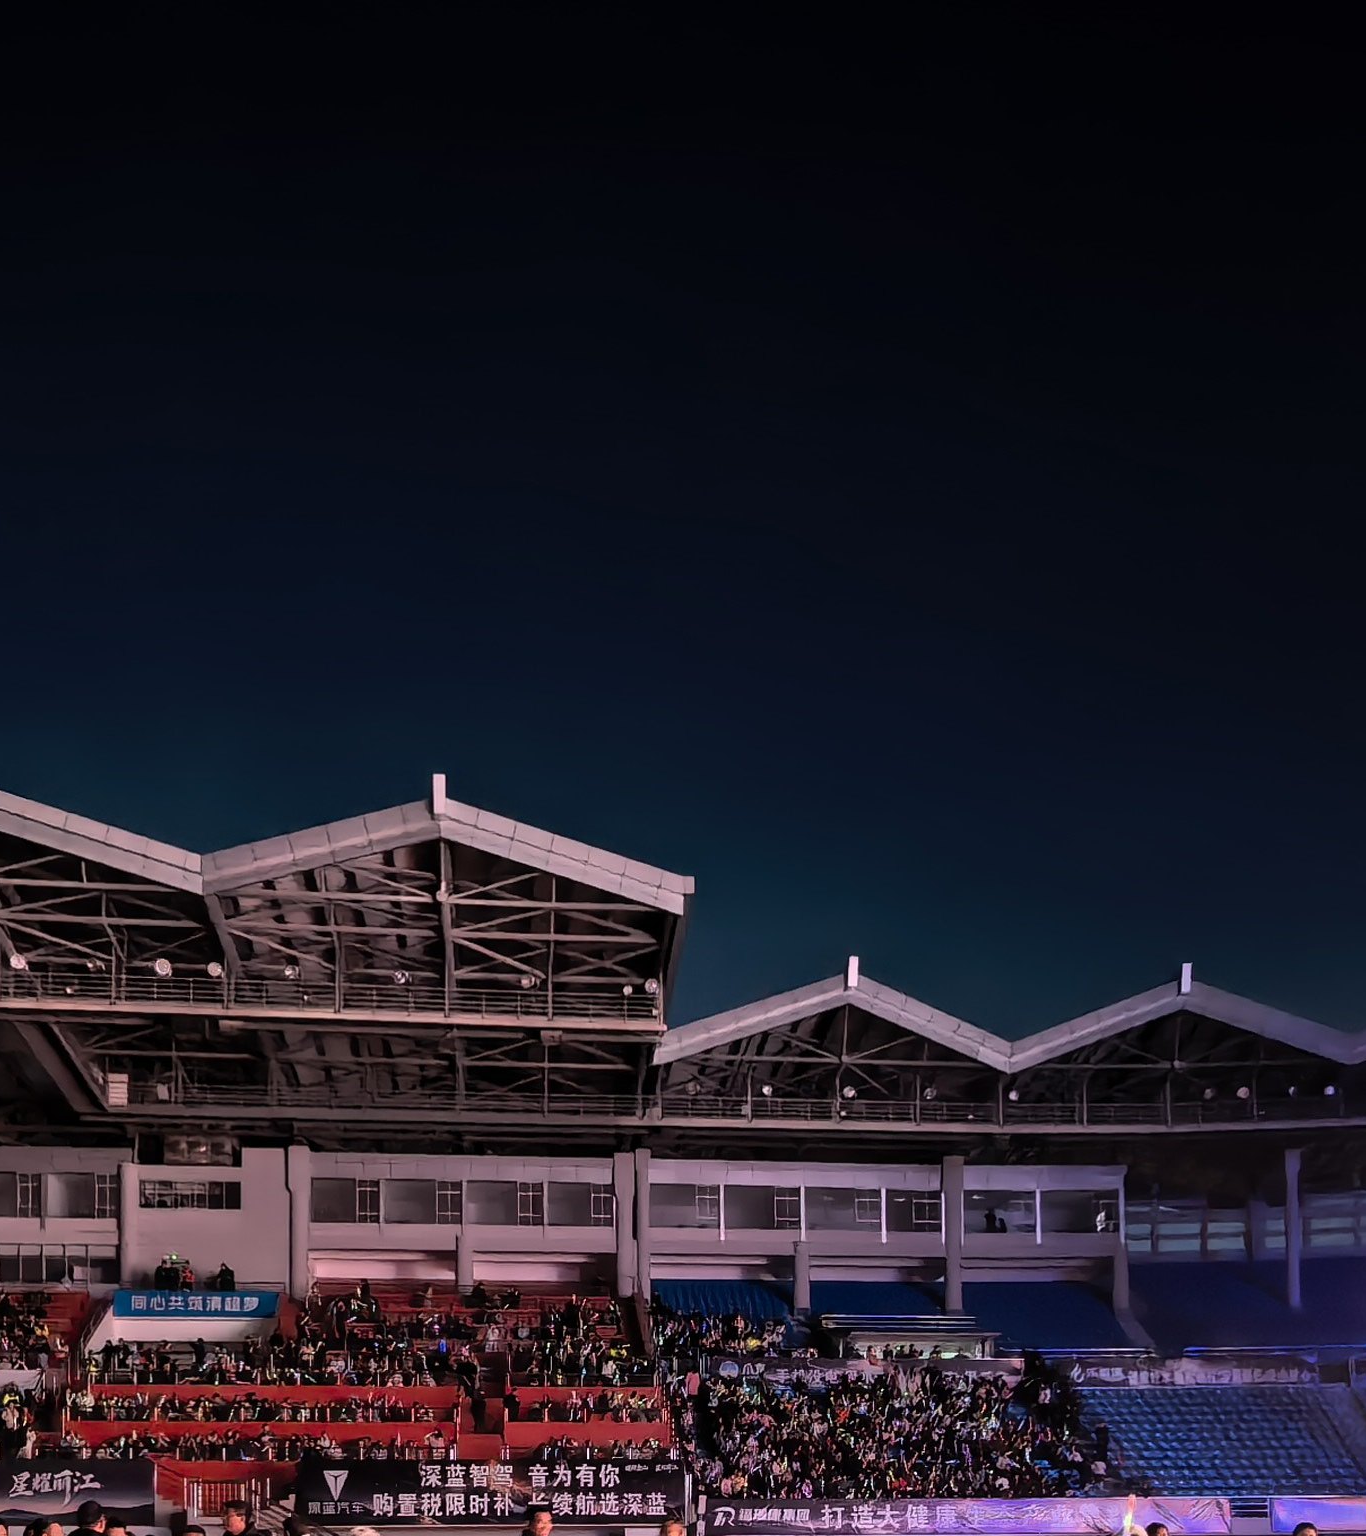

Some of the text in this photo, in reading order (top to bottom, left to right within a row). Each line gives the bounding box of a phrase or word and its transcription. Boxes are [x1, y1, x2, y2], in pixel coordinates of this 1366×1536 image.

[9, 1469, 101, 1507] 星耀丽江
[420, 1464, 621, 1488] 深蓝智驾 音为有你
[372, 1493, 515, 1517] 购置税限时补
